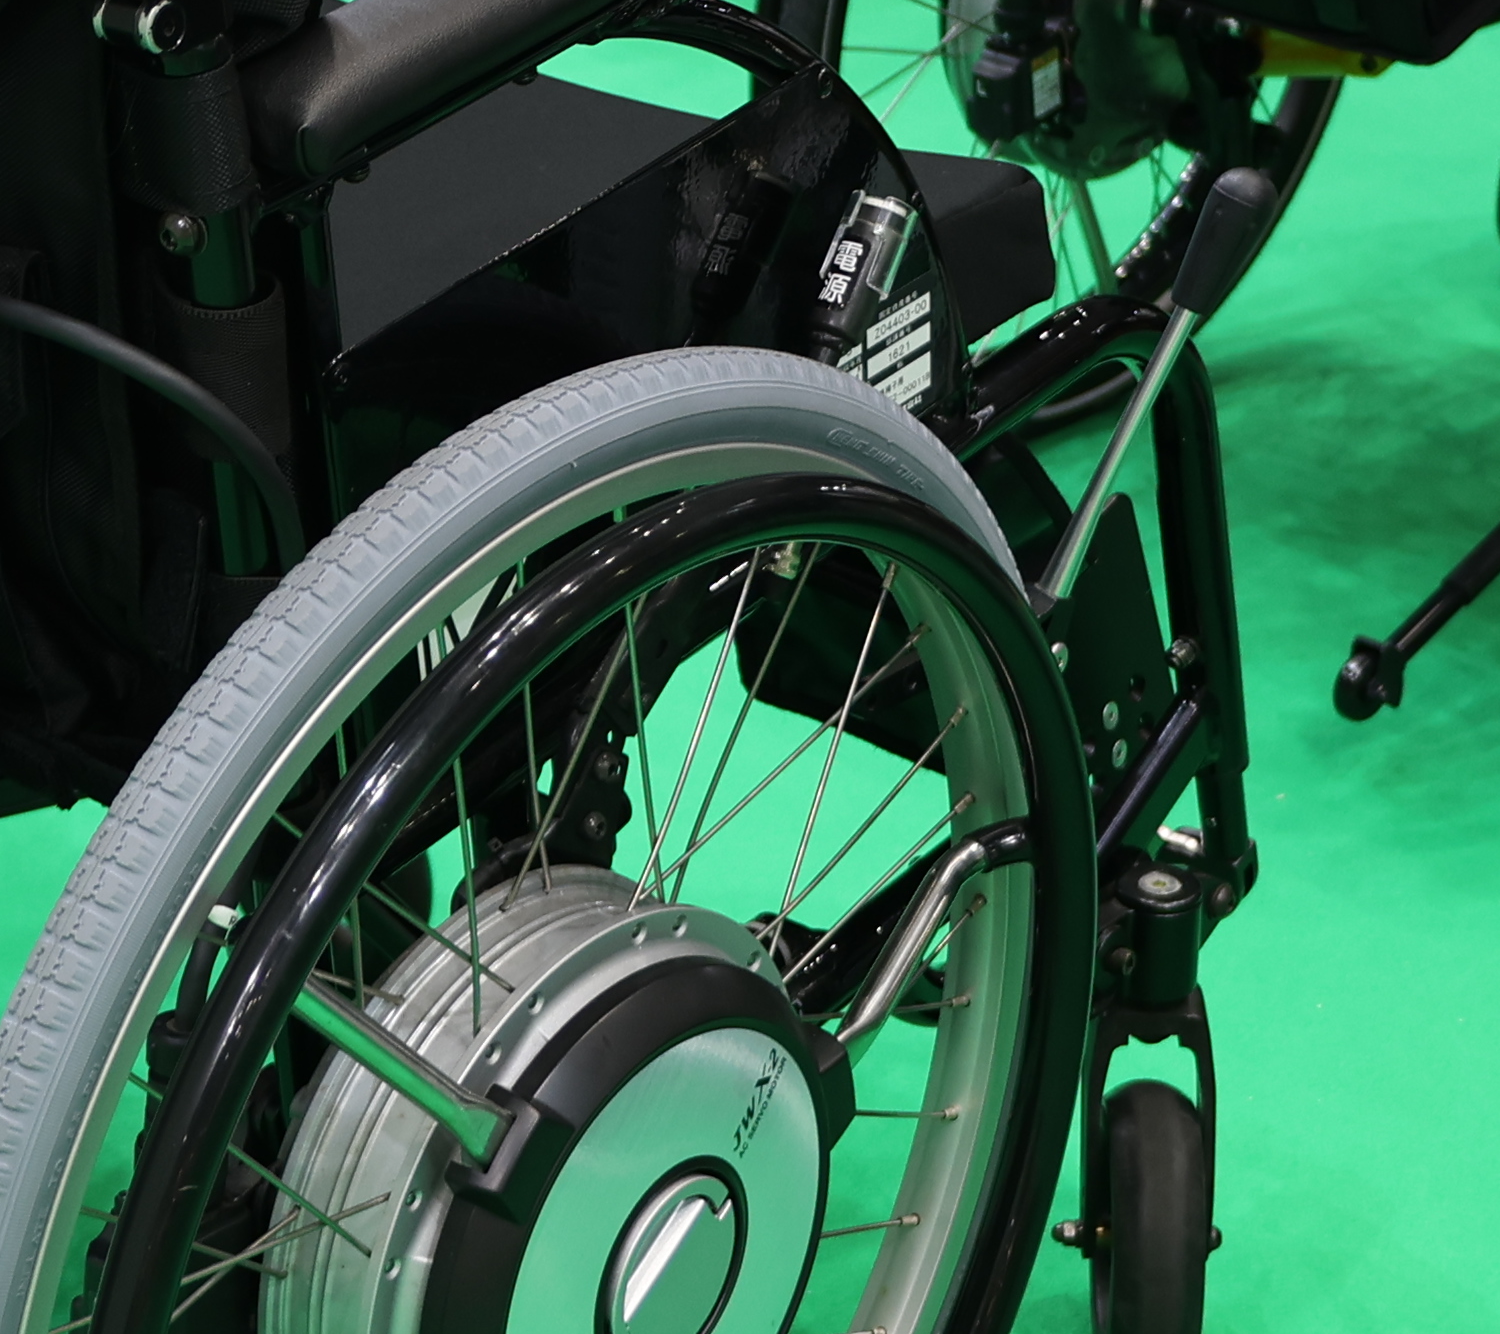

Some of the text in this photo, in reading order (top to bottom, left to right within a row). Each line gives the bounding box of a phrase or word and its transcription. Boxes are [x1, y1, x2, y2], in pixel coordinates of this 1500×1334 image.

[818, 240, 864, 306] 電源
[888, 341, 911, 362] 1621
[747, 1100, 769, 1140] SERVO
[766, 1056, 787, 1100] MOTOR
